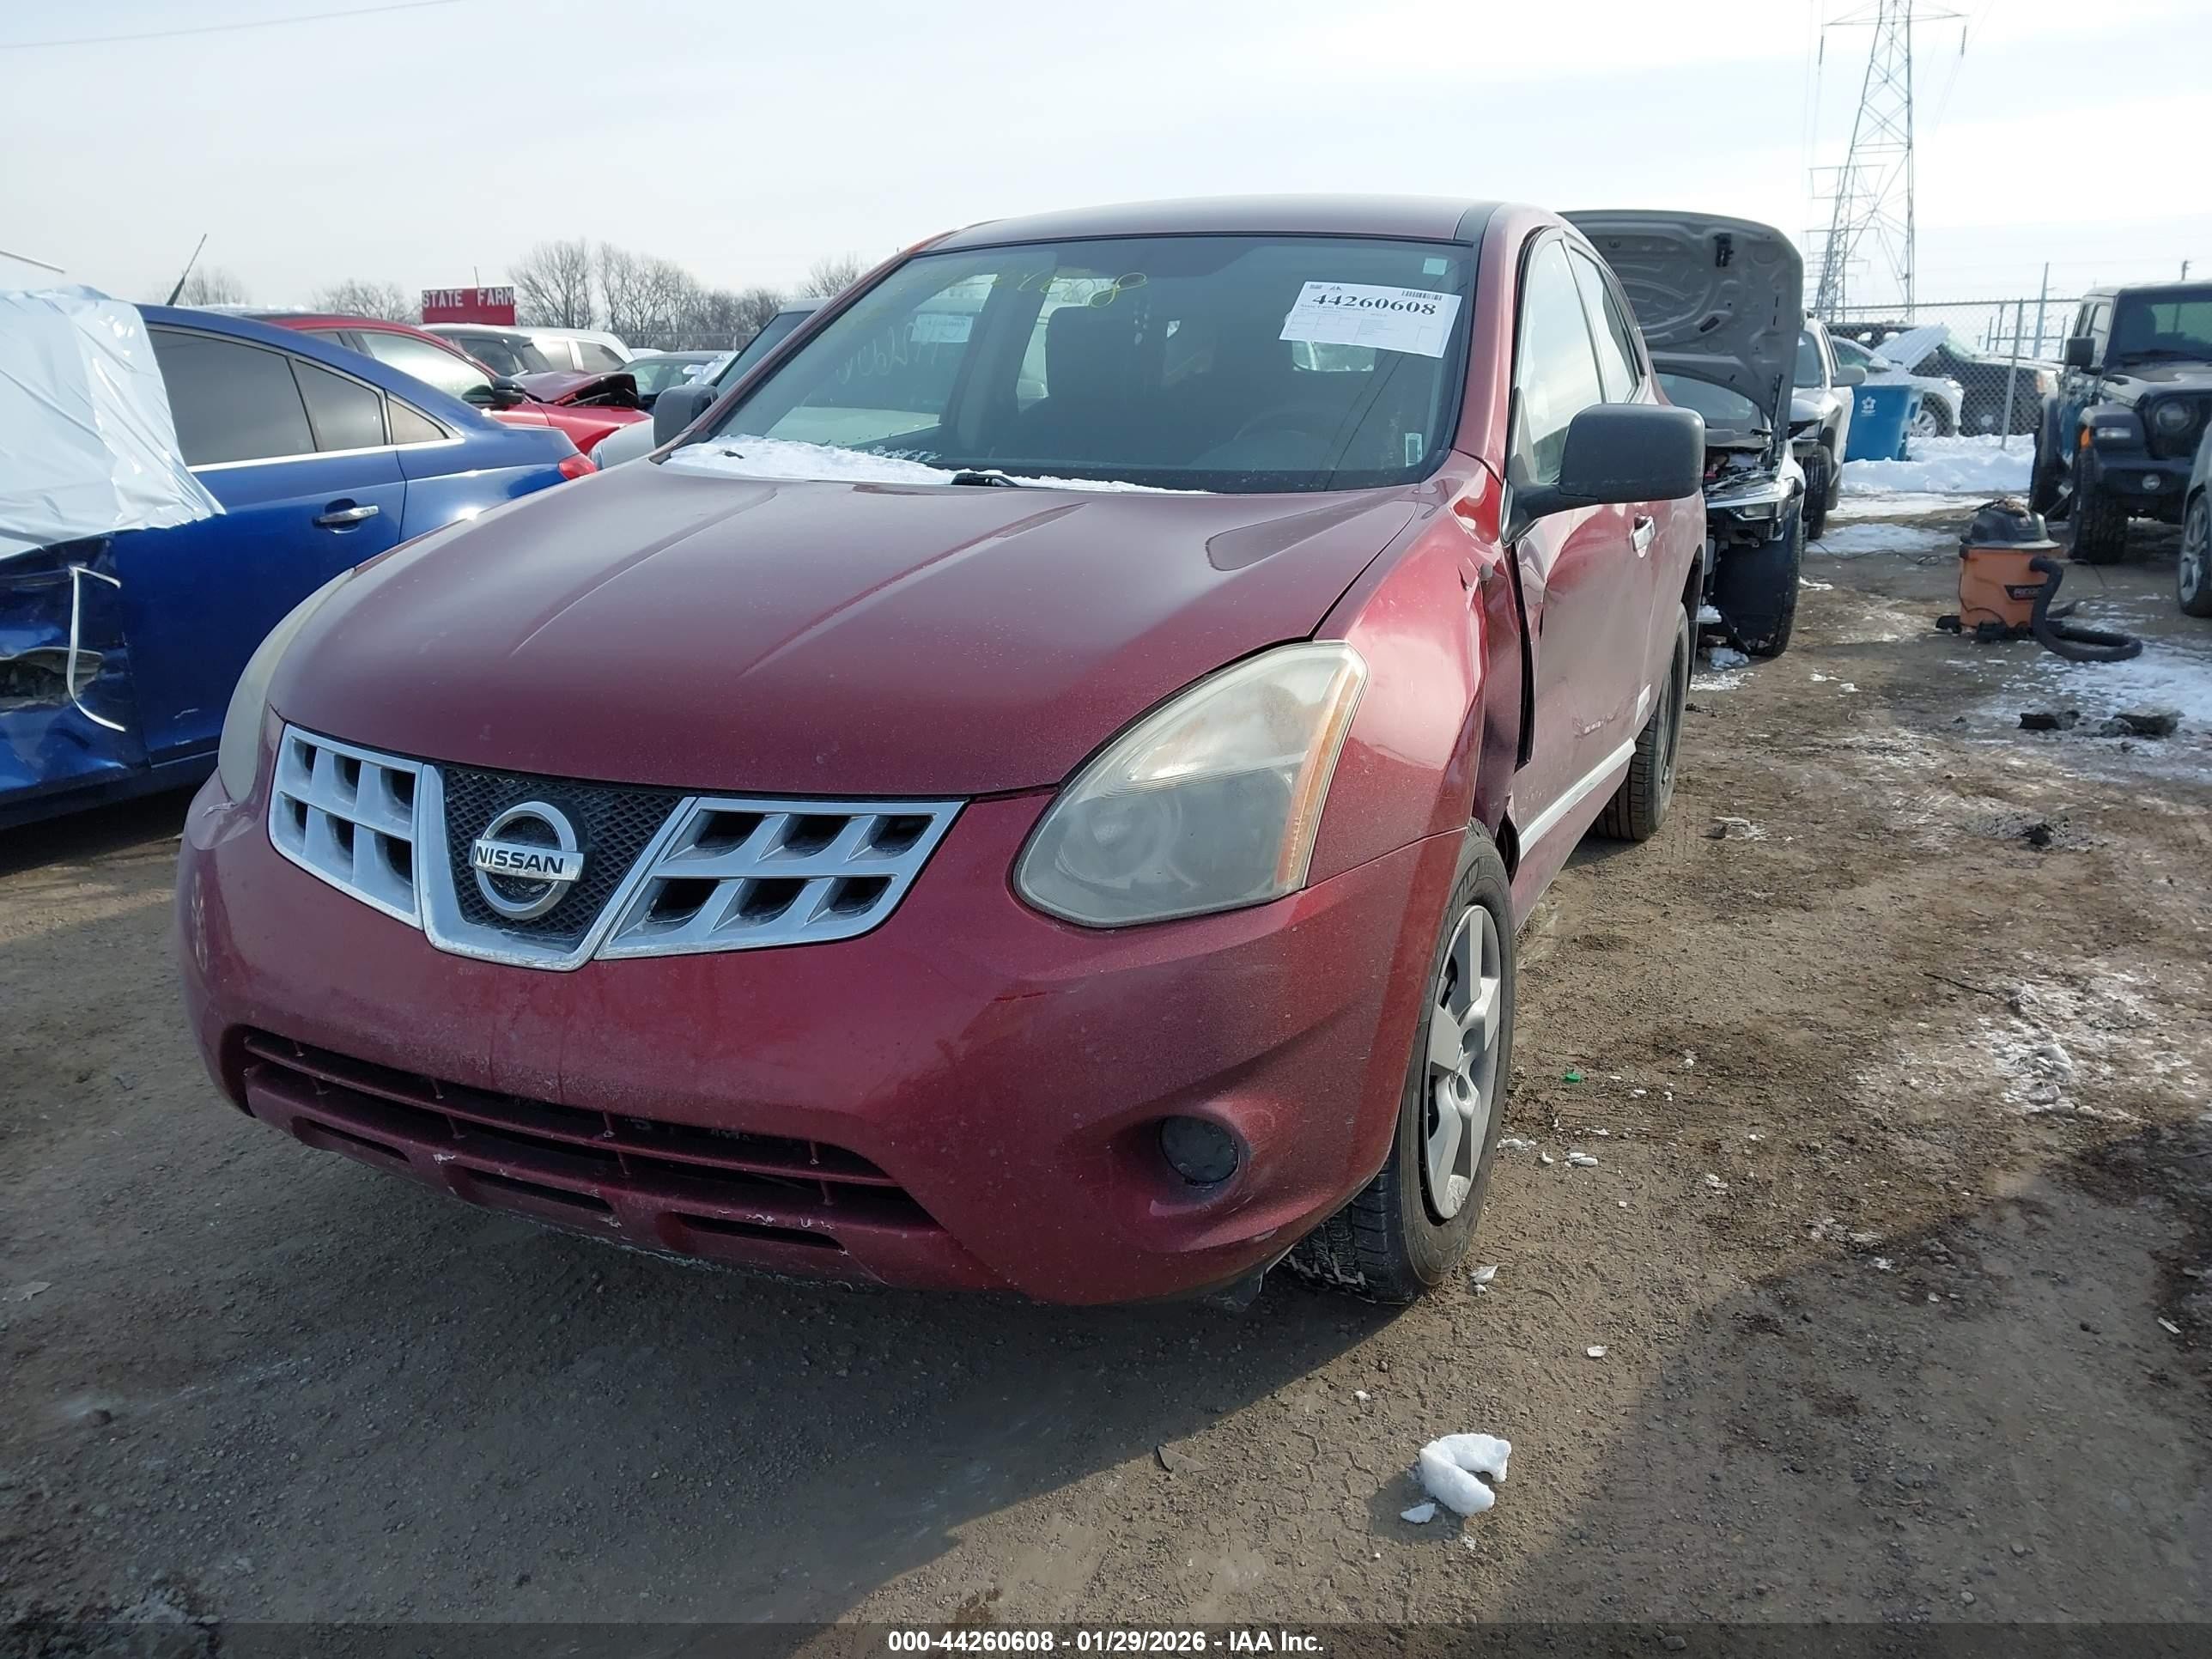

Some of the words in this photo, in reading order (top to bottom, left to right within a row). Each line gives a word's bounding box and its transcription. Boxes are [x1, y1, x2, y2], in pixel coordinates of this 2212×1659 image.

[422, 290, 464, 308] STATE
[477, 287, 514, 307] FARM
[1312, 294, 1437, 316] 44260608
[475, 846, 564, 874] NISSAN
